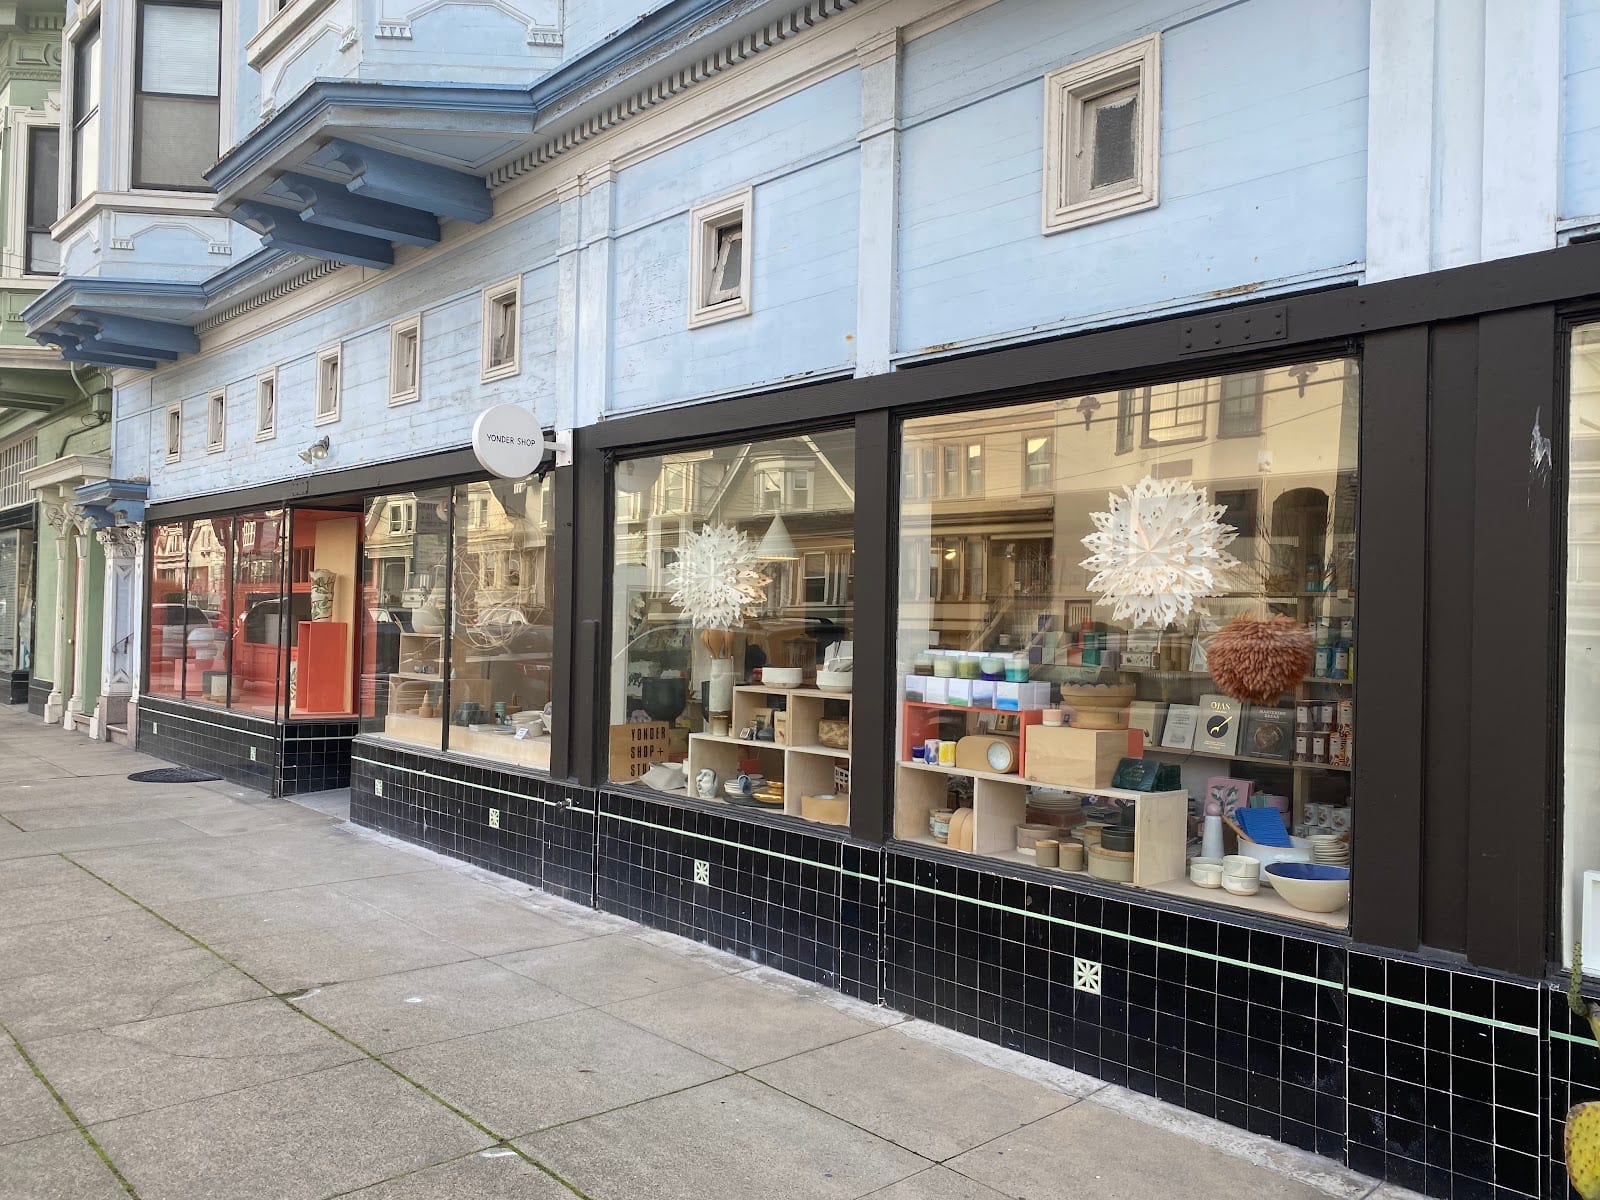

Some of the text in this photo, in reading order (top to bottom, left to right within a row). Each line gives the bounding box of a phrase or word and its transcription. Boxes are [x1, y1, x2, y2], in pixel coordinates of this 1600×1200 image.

[486, 433, 535, 446] YONDER SHOP
[1210, 701, 1231, 711] OJAS
[631, 726, 665, 741] YONDER
[630, 745, 664, 758] SHOP +
[630, 763, 651, 776] STU
